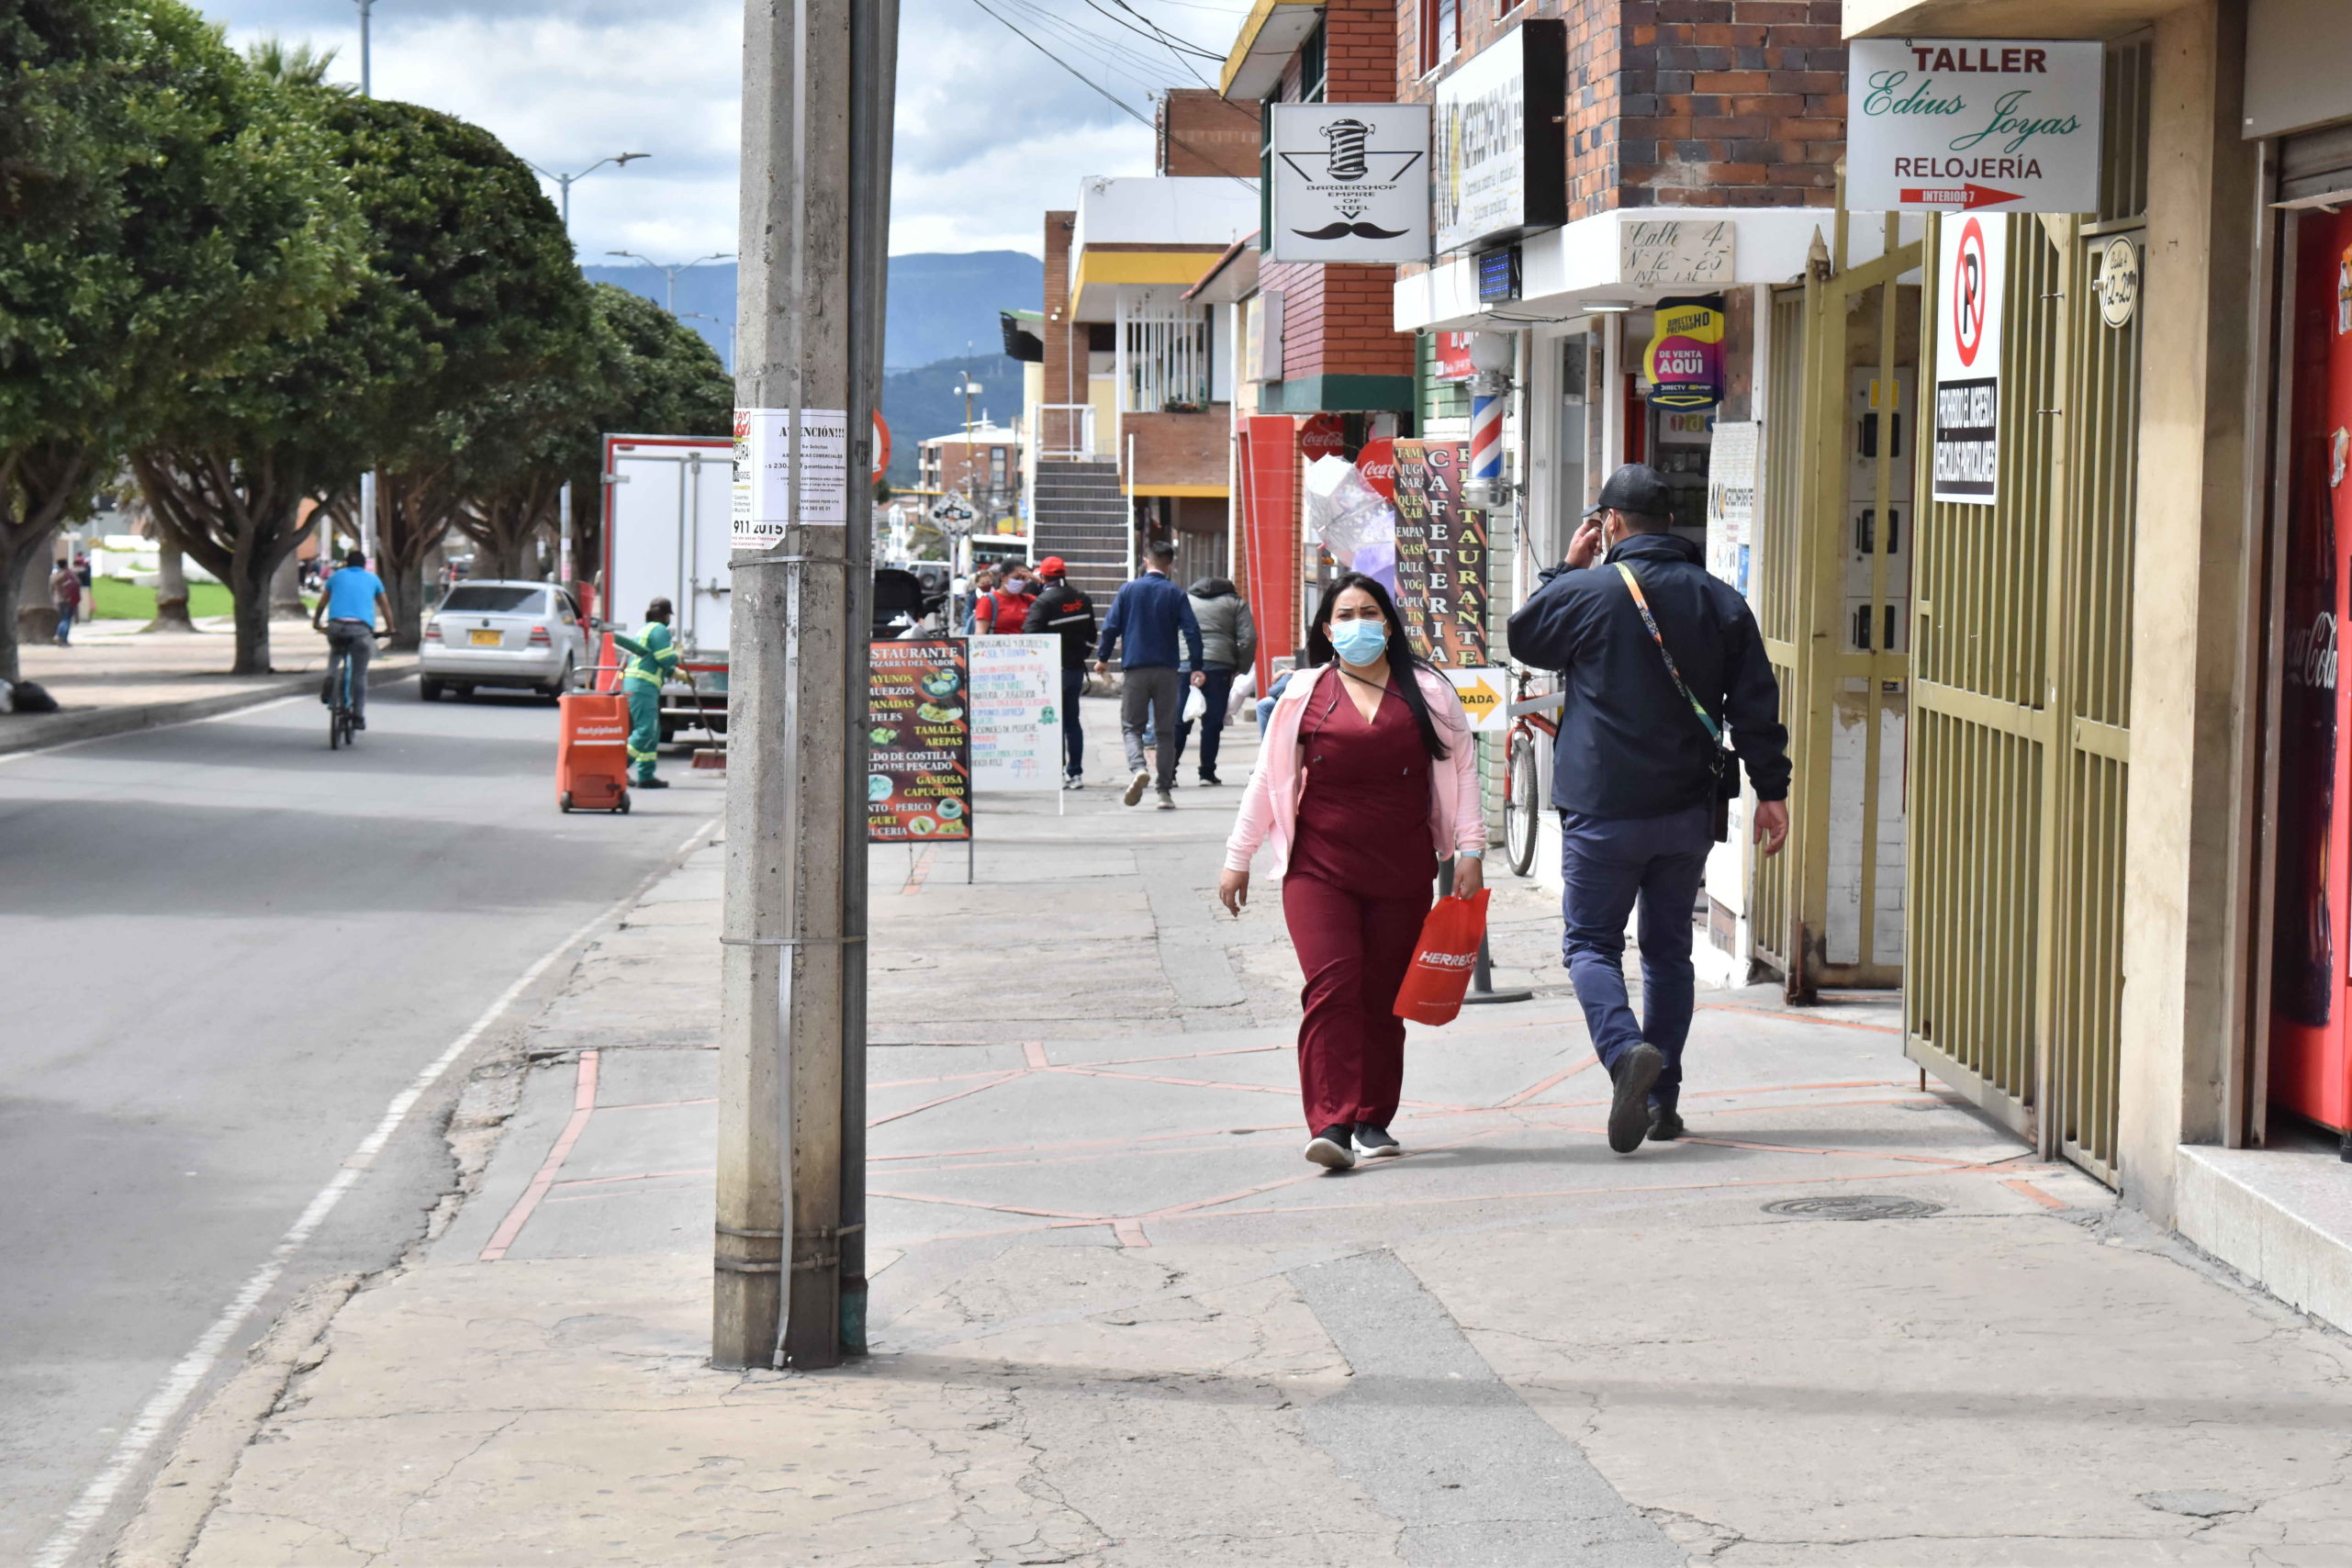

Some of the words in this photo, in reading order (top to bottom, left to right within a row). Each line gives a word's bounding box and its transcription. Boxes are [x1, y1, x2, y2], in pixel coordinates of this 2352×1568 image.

[1911, 47, 2047, 73] TALLER
[1863, 71, 1966, 116] Edius
[1949, 90, 2080, 154] Joyas
[1894, 154, 2043, 179] RELOJERÍA
[1922, 190, 1967, 203] INTERIOR
[1968, 191, 1975, 202] 7
[1702, 221, 1725, 248] 4
[1667, 315, 1693, 328] DIRECTV
[1693, 312, 1710, 328] HD
[1673, 350, 1702, 358] VENTA
[1659, 359, 1703, 374] AQUI
[778, 425, 845, 438] ANCIÓN!!!
[734, 521, 749, 534] 911
[1428, 449, 1450, 664] CAFETERIA
[1457, 448, 1480, 666] RTAURANTE
[870, 646, 958, 659] STAURANTE
[870, 674, 913, 683] AYUNOS
[1461, 695, 1495, 704] RADA
[914, 725, 962, 735] TAMALES
[925, 736, 963, 746] AREPAS
[890, 752, 905, 761] DE
[906, 751, 957, 760] COSTILLA
[890, 762, 905, 771] DE
[906, 762, 952, 771] PESCADO
[916, 775, 963, 784] GASEOSA
[903, 787, 965, 797] CAPUCHINO
[895, 802, 932, 812] PERICO
[868, 815, 897, 824] GURT
